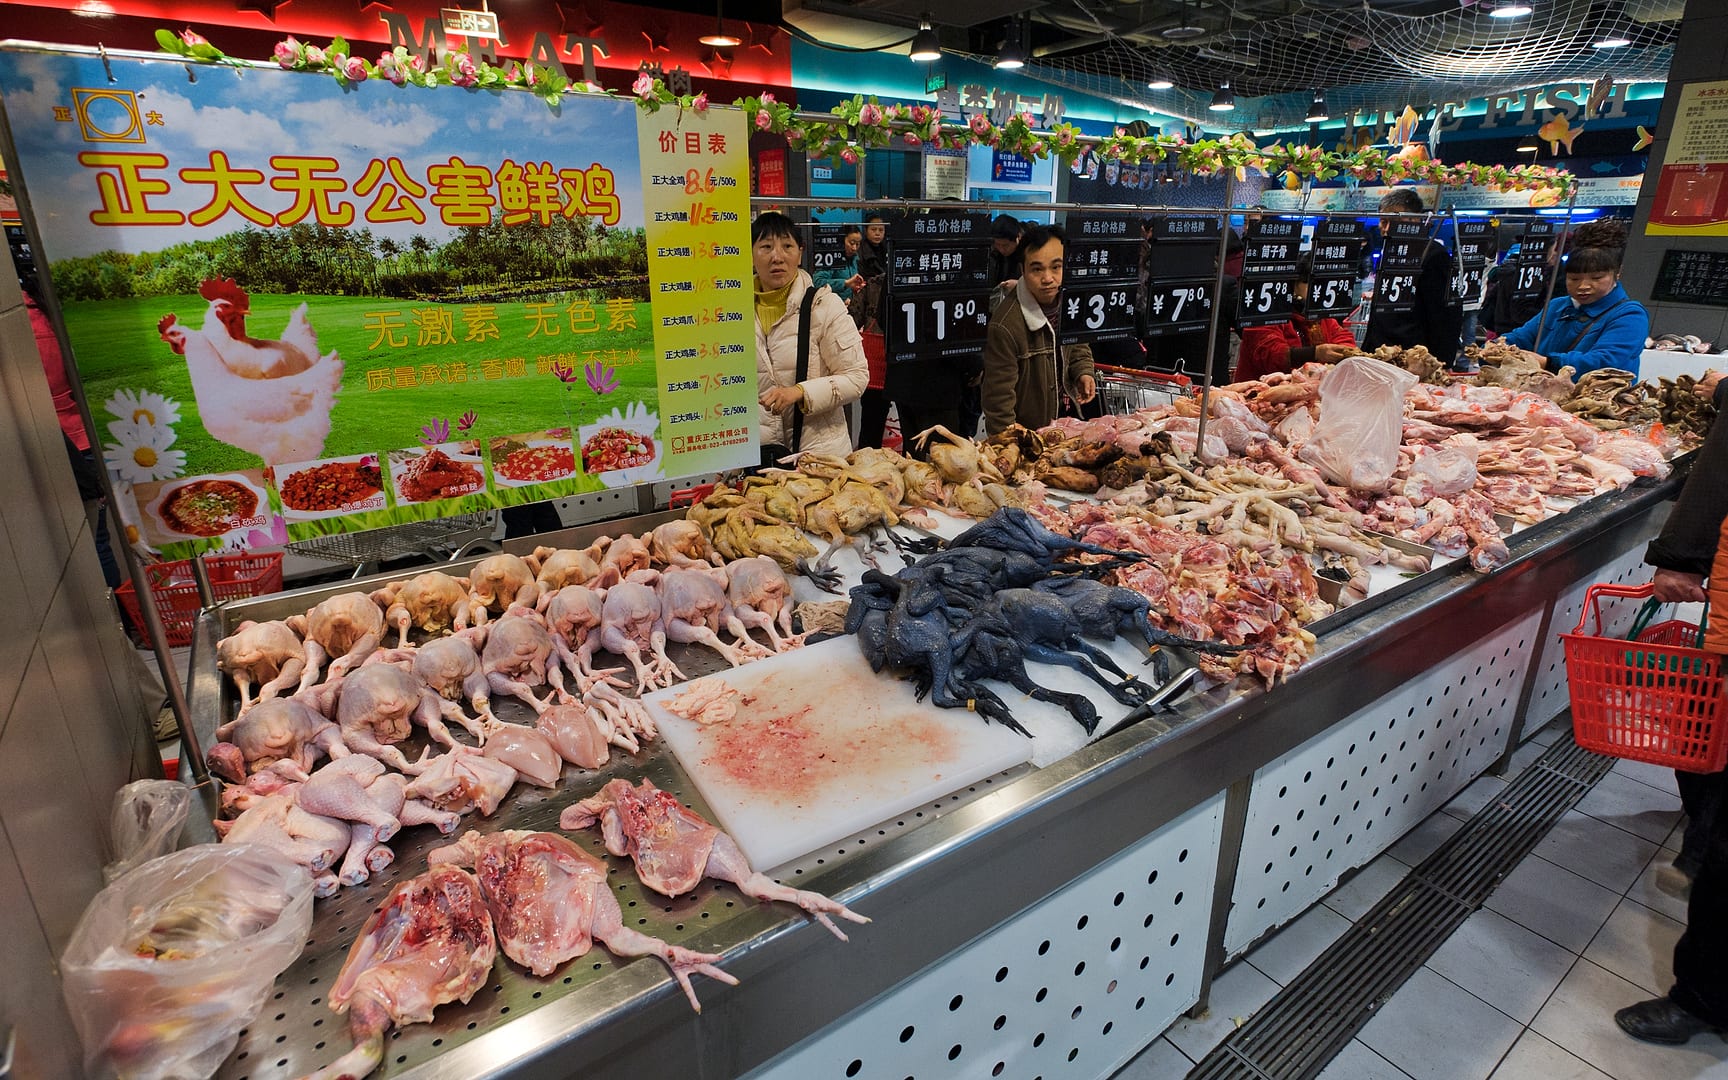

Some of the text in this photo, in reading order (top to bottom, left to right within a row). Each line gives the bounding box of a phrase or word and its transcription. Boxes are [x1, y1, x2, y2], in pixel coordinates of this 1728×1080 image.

[53, 106, 164, 126] 正 大
[658, 130, 727, 155] 价目表
[77, 150, 621, 227] 正大无公害鲜鸡
[684, 167, 714, 194] 8.6
[915, 219, 972, 234] 商品价格牌
[1083, 220, 1127, 234] 商品价格牌
[1168, 220, 1206, 233] 商品价格牌
[1260, 224, 1292, 235] 商品价格牌
[1328, 223, 1355, 234] 商品价格牌
[1089, 249, 1109, 265] 鸡架
[1261, 245, 1288, 259] 筒子骨
[919, 252, 962, 271] 鲜乌骨鸡
[363, 297, 638, 351] 无激素 无色素
[536, 351, 578, 376] 新鲜
[581, 347, 643, 369] 不注水
[700, 372, 723, 394] 7.5
[704, 403, 722, 422] 1.5
[687, 427, 748, 444] 重庆正大有限公司
[450, 482, 478, 495] 炸鸡腿
